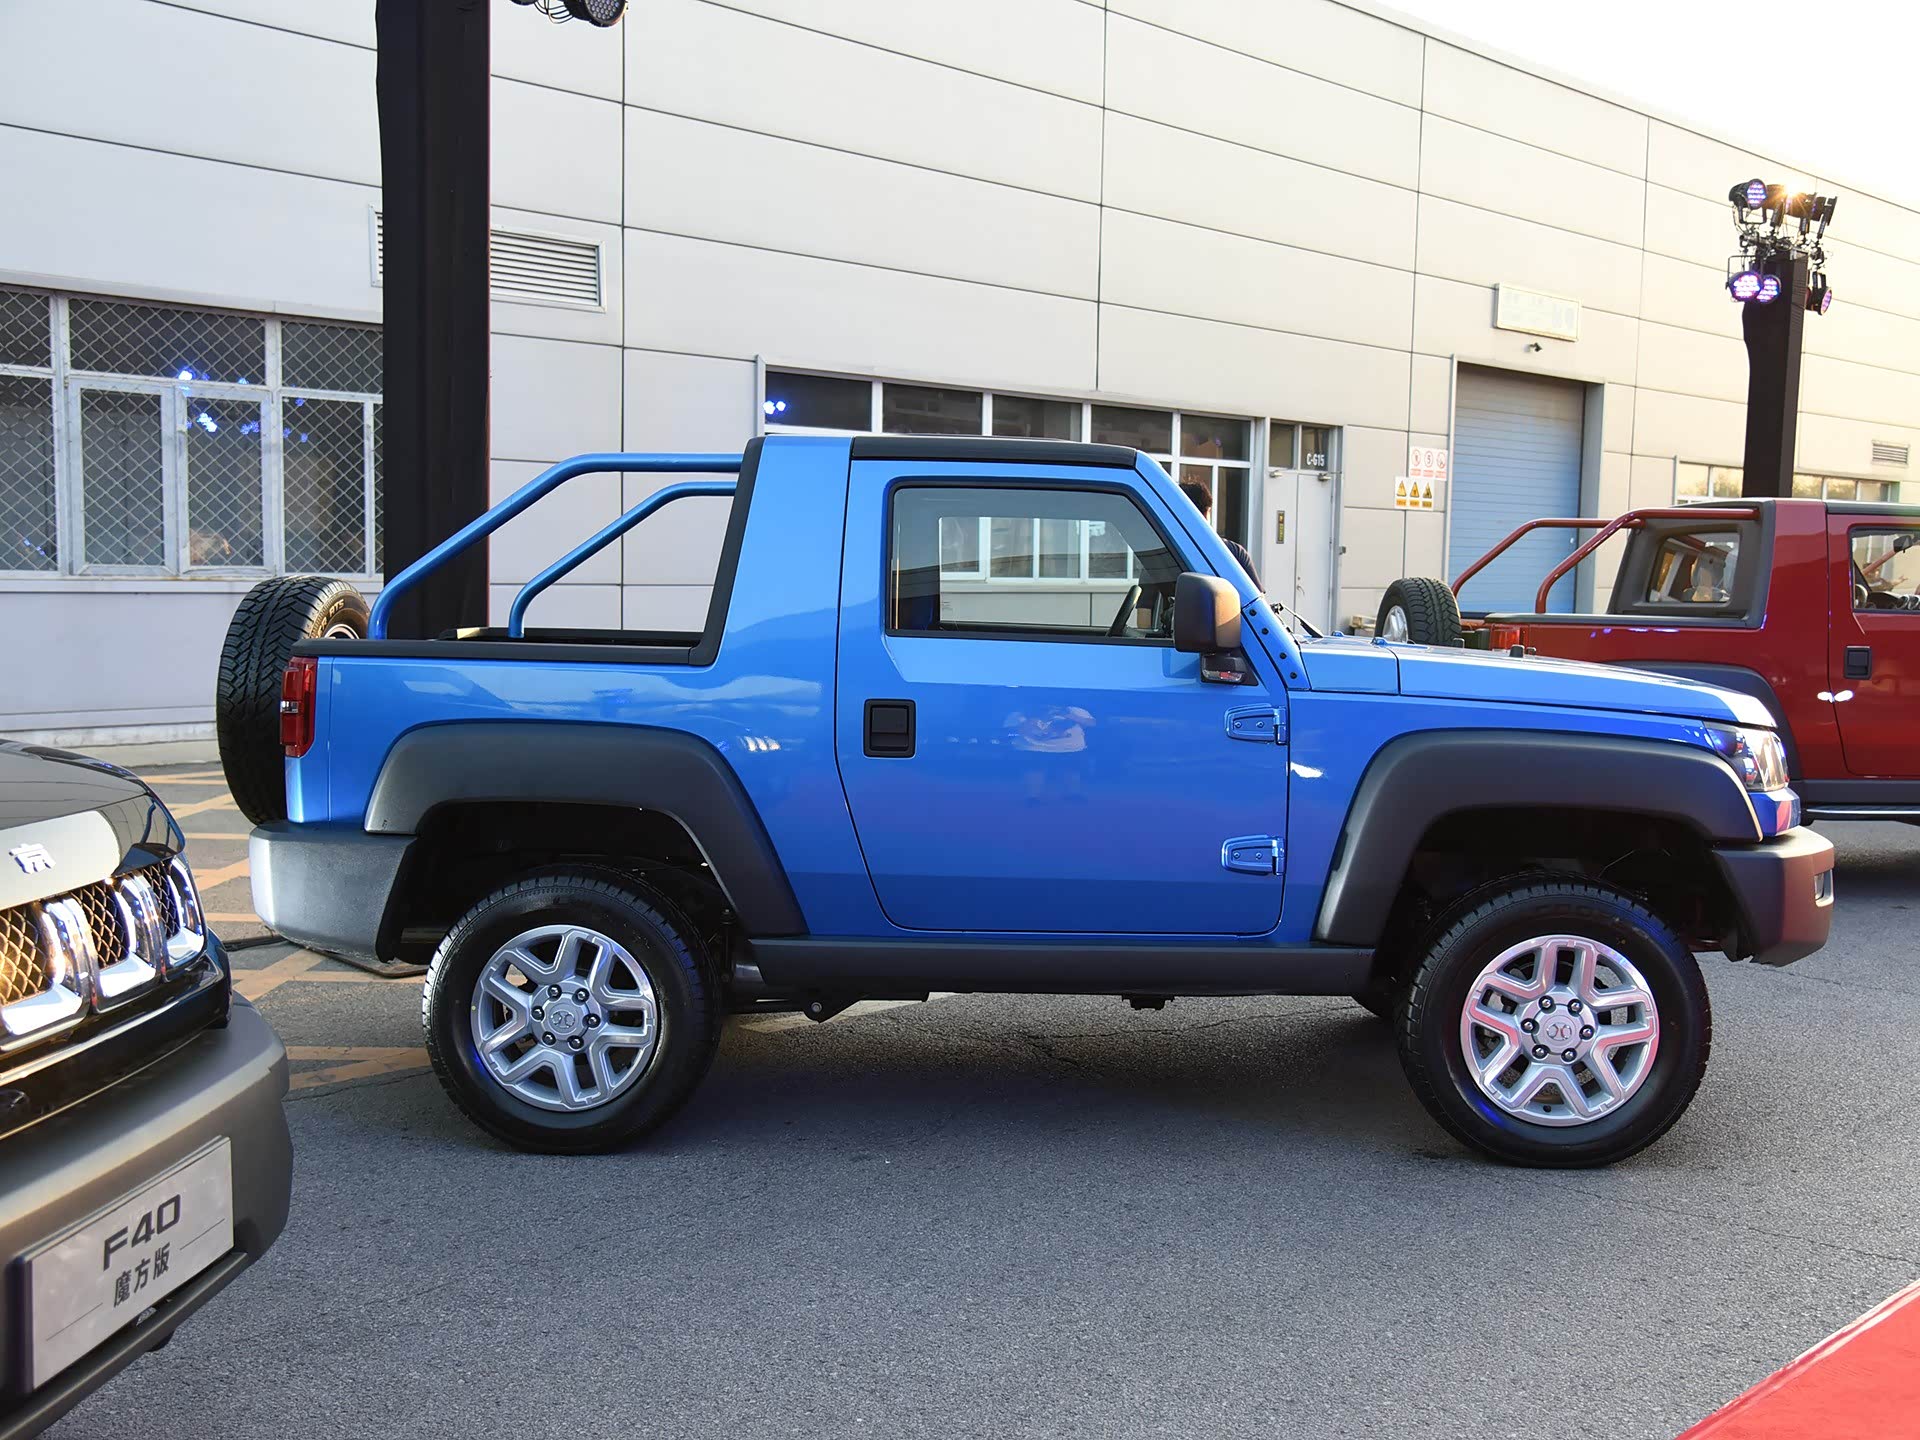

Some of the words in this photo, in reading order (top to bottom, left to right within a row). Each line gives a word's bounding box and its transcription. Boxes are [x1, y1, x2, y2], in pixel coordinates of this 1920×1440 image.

[103, 1193, 181, 1272] F40
[113, 1241, 171, 1308] 魔方版
